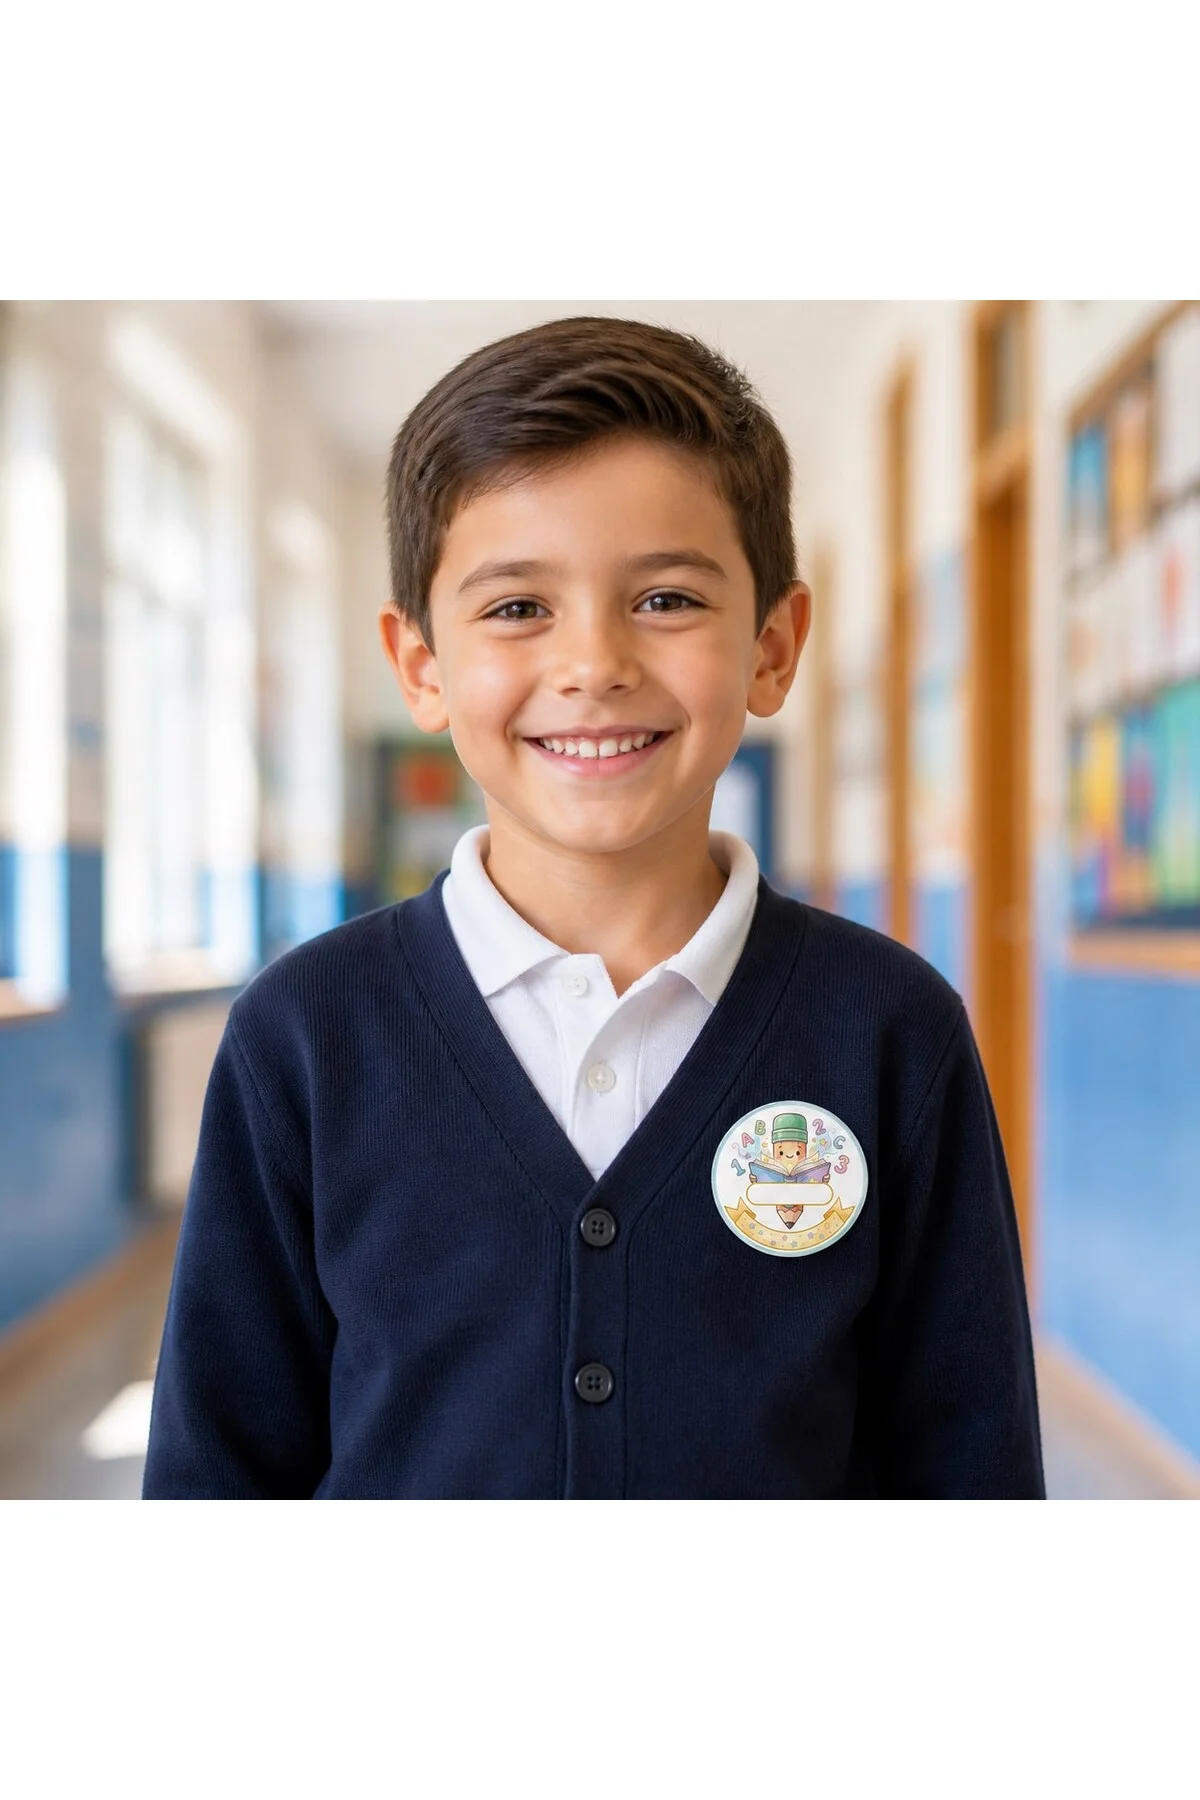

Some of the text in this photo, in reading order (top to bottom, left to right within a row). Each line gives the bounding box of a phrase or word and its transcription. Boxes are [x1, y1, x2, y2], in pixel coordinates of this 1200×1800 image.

[755, 1120, 766, 1135] B
[812, 1118, 826, 1135] 2
[741, 1132, 754, 1148] A
[833, 1136, 846, 1149] C
[731, 1158, 746, 1176] 1
[834, 1155, 849, 1174] 3
